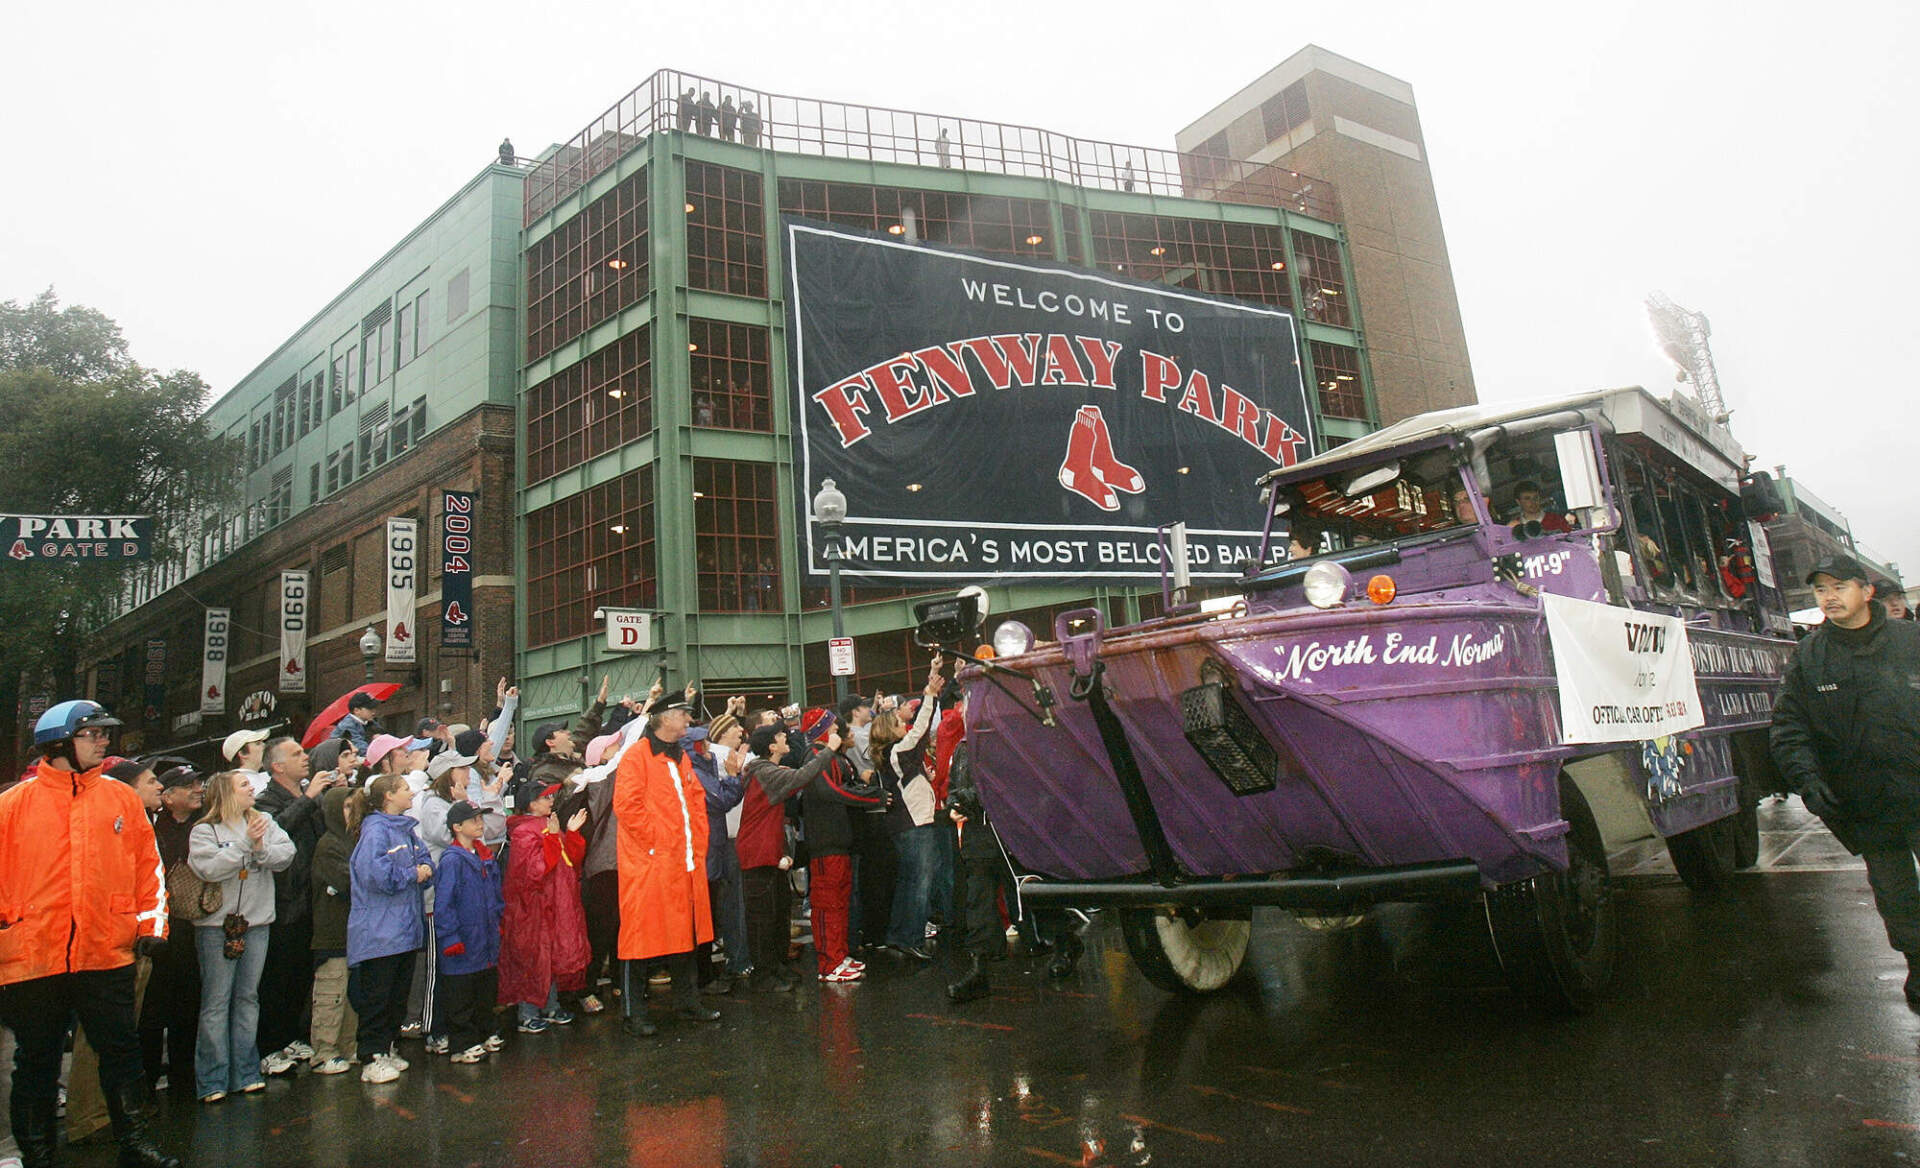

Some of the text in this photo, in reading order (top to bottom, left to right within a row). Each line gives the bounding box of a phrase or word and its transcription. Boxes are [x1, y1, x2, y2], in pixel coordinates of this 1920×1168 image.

[961, 277, 1185, 333] WELCOME TO
[812, 332, 1307, 469] FENWAY PARK
[18, 517, 139, 539] PARK
[445, 494, 471, 574] 2004
[41, 542, 139, 557] GATE D
[391, 522, 414, 590] 1995
[822, 532, 1000, 564] AMERICA'S
[1010, 540, 1089, 564] MOST
[285, 576, 305, 631] 1990
[616, 615, 642, 624] GATE
[207, 612, 228, 661] 1988
[620, 627, 639, 645] D
[1383, 632, 1440, 665] End
[1592, 705, 1626, 724] OFFIC
